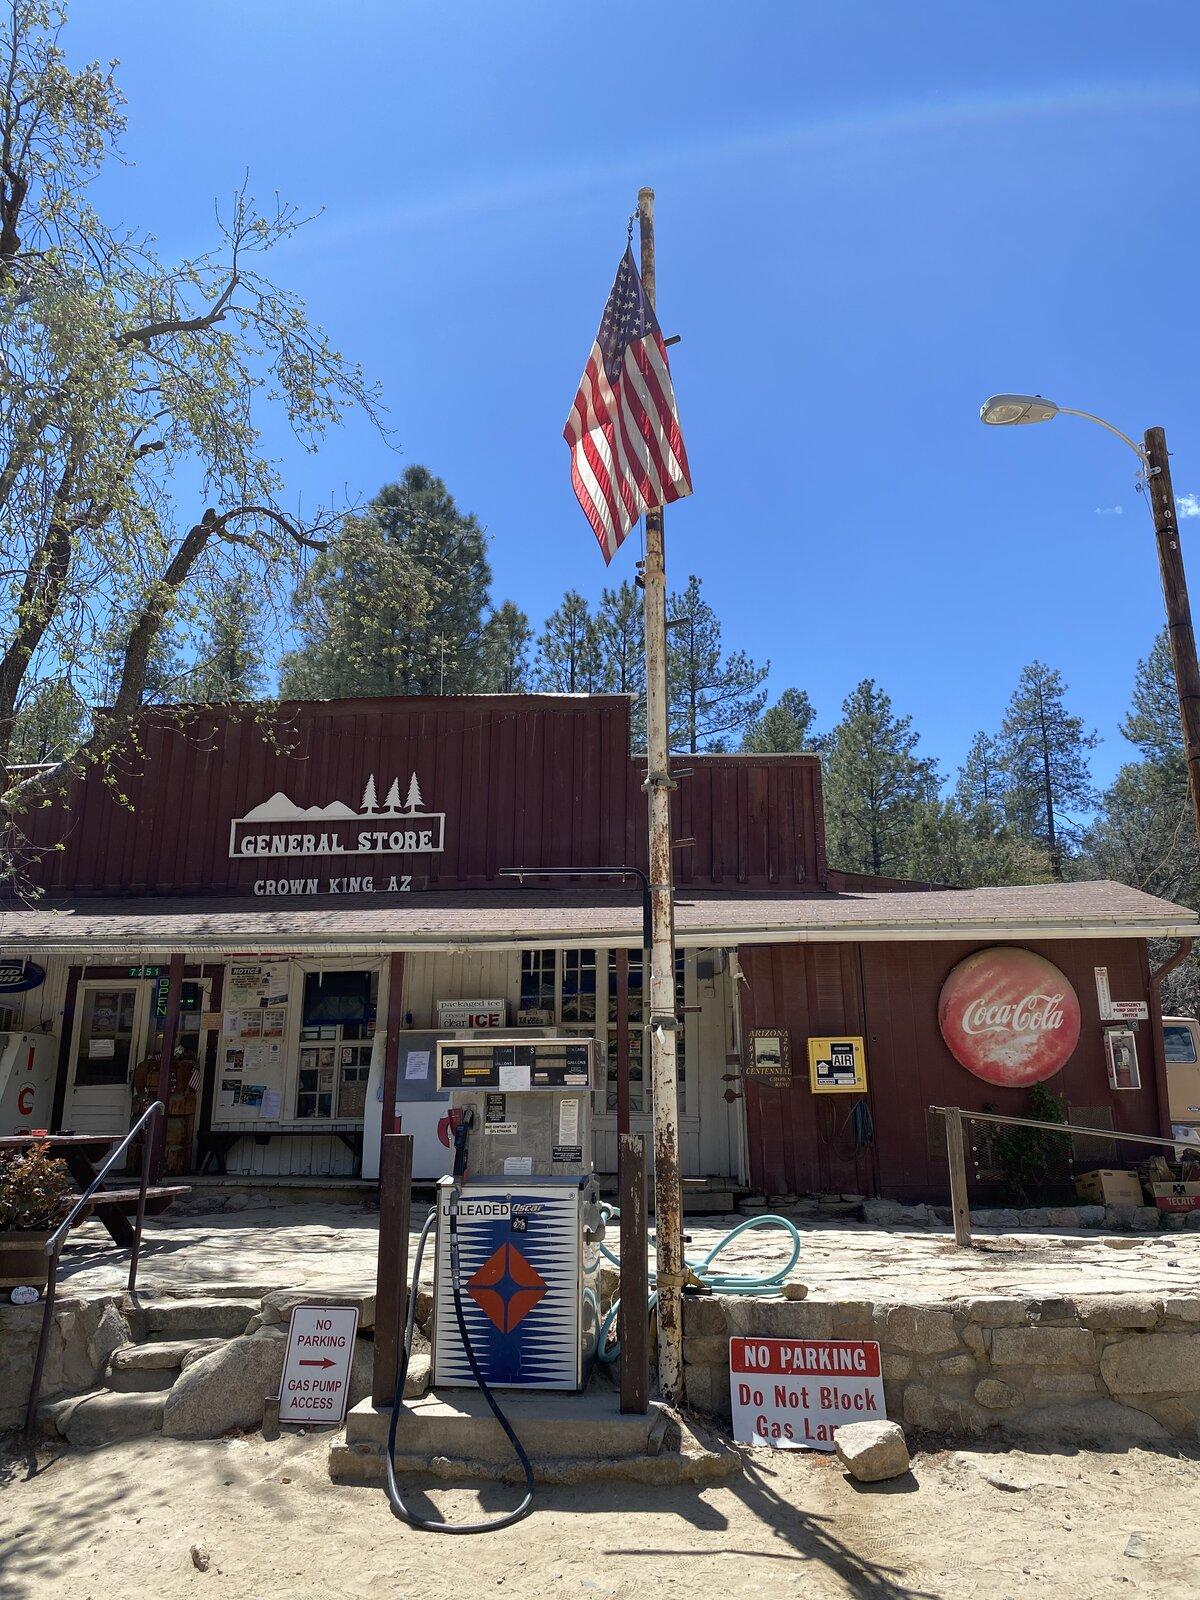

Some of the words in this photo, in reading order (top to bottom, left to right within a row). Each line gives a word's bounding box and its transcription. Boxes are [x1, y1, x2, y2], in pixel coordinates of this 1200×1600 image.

[240, 833, 344, 855] GENERAL
[357, 831, 433, 851] STORE
[253, 878, 319, 896] CROWN
[387, 875, 412, 892] AZ
[156, 978, 170, 1016] OPEN
[440, 1000, 485, 1009] packaged
[468, 1013, 500, 1028] ICE
[962, 993, 1065, 1036] Coca-Cola
[443, 1018, 467, 1028] clear
[748, 1029, 789, 1038] ARIZONA
[446, 1059, 455, 1068] 87
[834, 1055, 852, 1066] AIR
[745, 1066, 792, 1075] CENTENNIAL
[1167, 1197, 1196, 1206] TECATE
[315, 1319, 332, 1331] NO
[297, 1335, 346, 1347] PARKING
[744, 1345, 771, 1368] NO
[780, 1346, 866, 1371] PARKING
[288, 1379, 310, 1391] GAS
[312, 1380, 342, 1392] PUMP
[290, 1396, 333, 1409] ACCESS
[738, 1383, 764, 1407] Do
[774, 1385, 810, 1409] Not
[819, 1386, 877, 1411] Block
[756, 1415, 794, 1440] Gas
